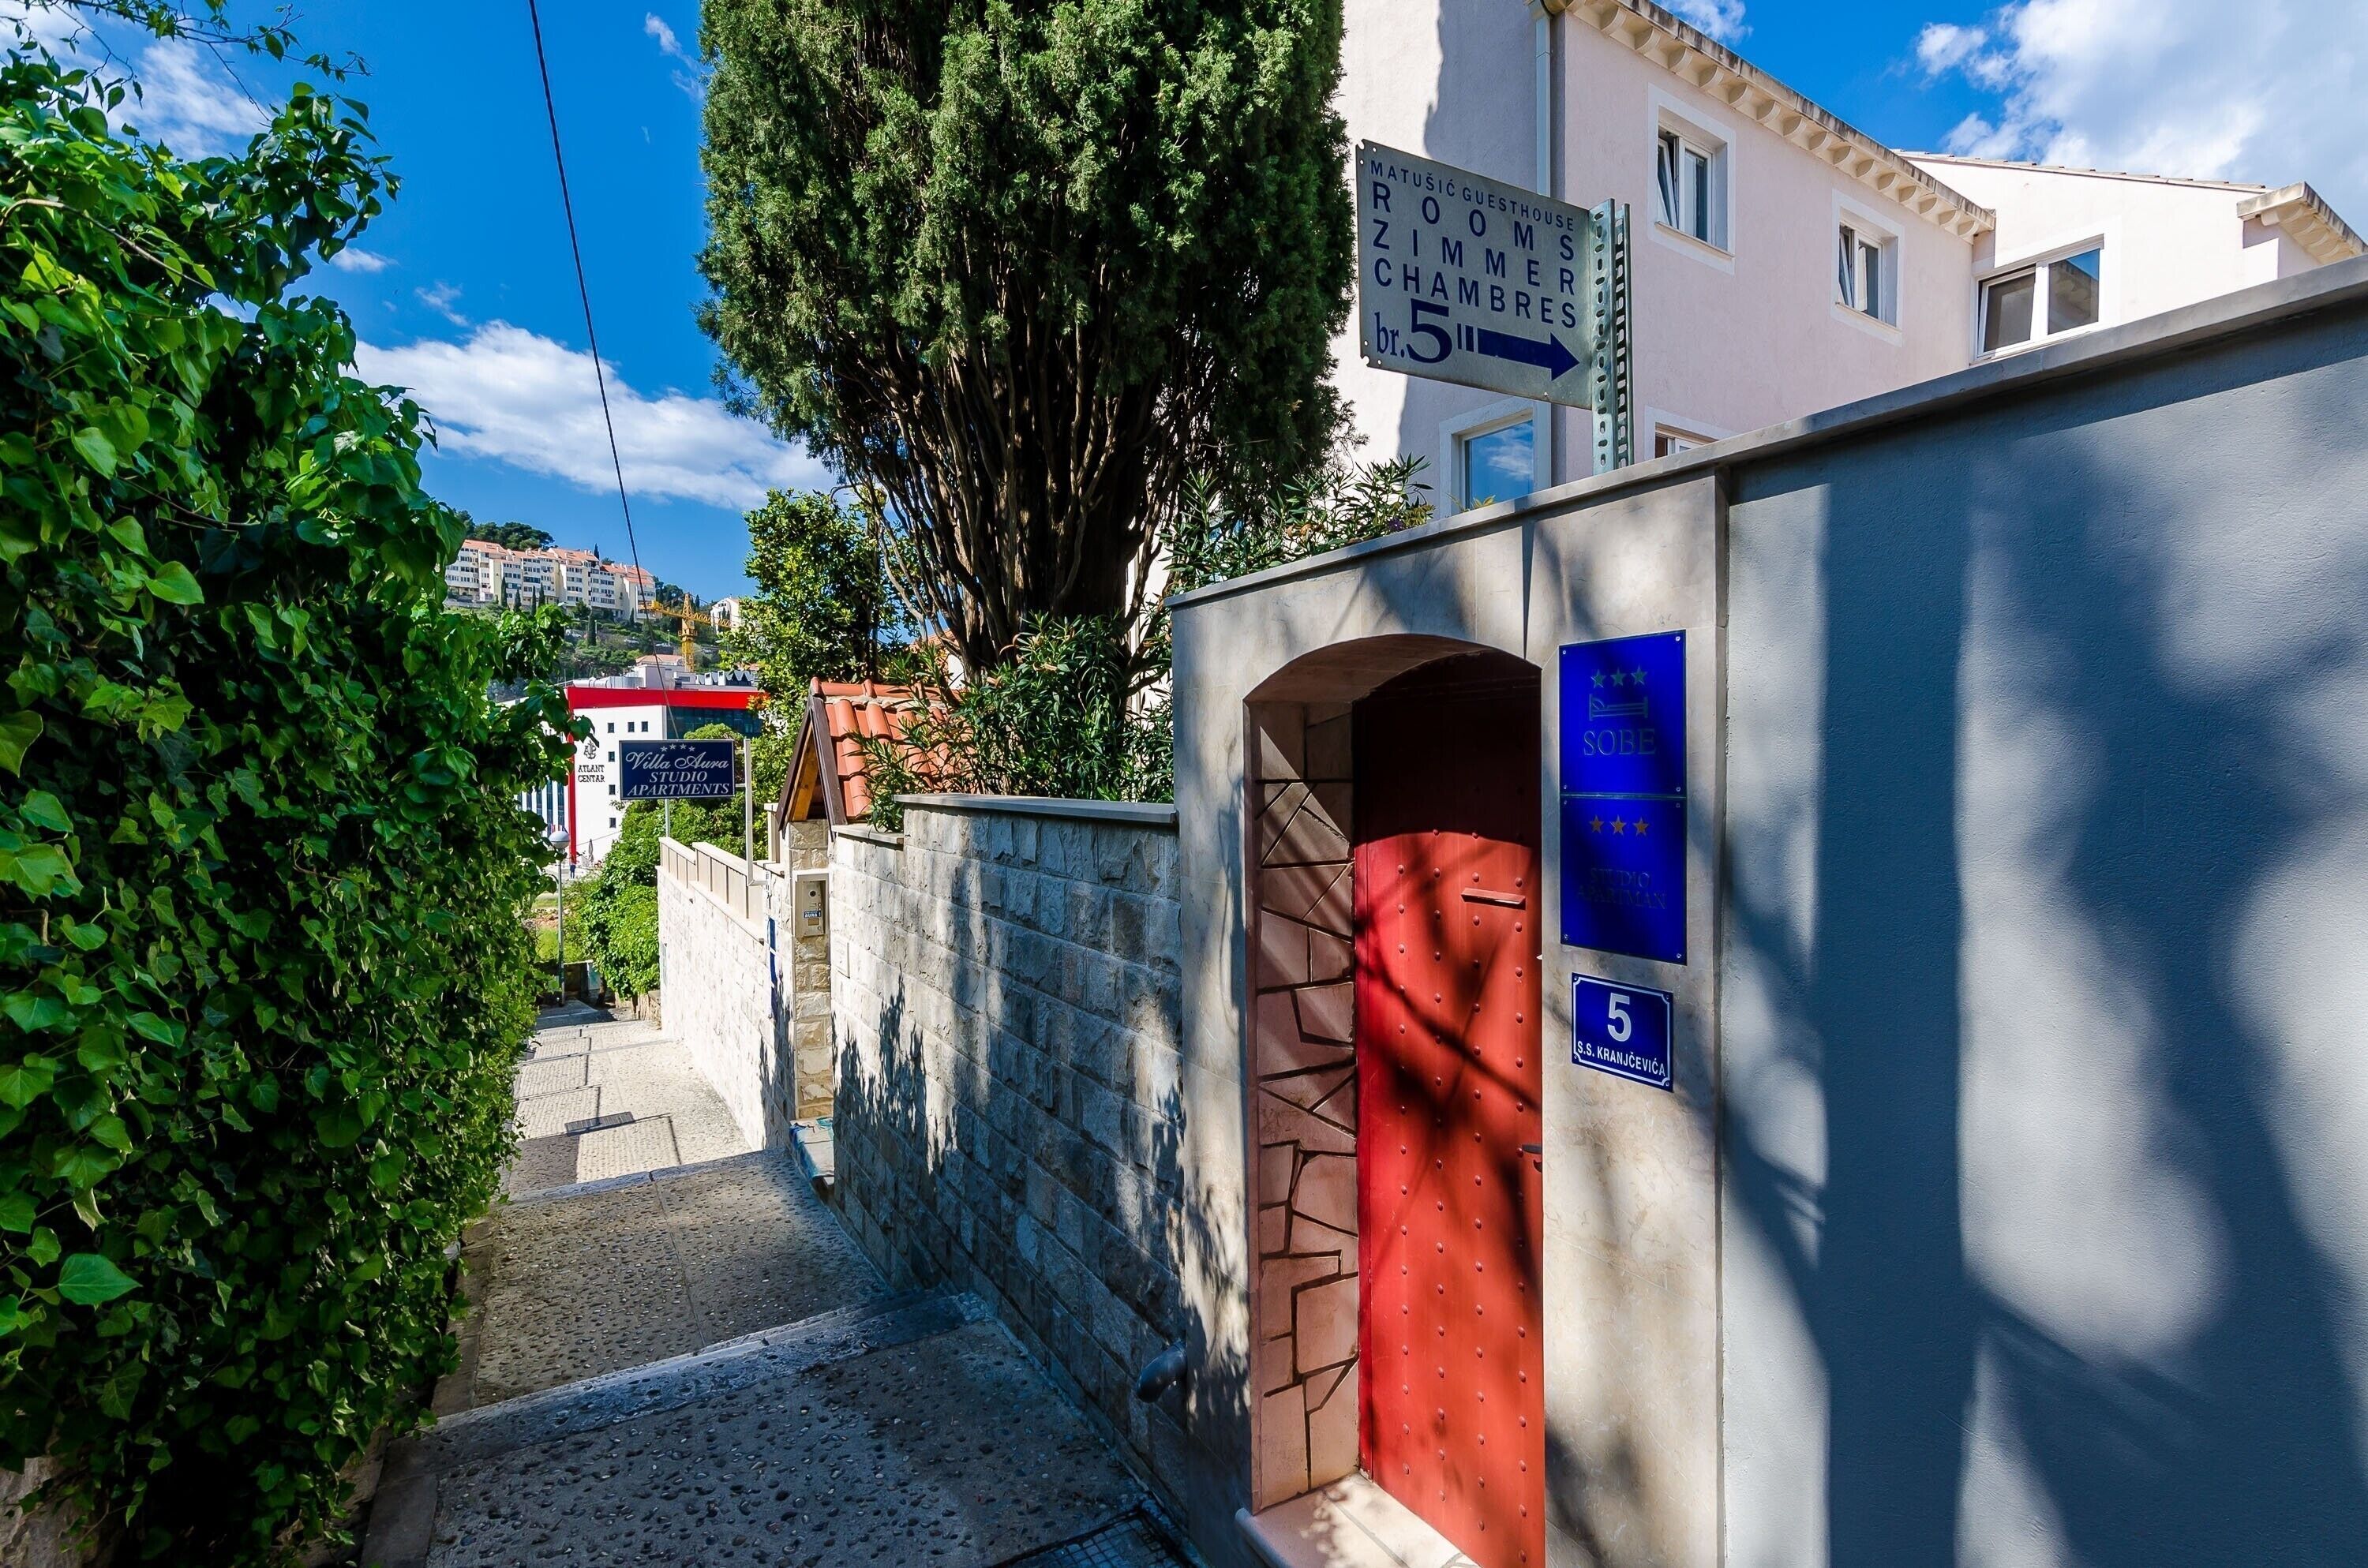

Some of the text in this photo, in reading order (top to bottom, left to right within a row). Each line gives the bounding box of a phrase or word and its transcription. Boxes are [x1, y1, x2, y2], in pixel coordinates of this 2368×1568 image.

[1370, 159, 1574, 231] MATUŠIĆ GUESTHOUSE
[1372, 181, 1575, 261] ROOMS
[1373, 219, 1575, 296] ZIMMER
[1374, 256, 1576, 329] CHAMBRES
[1583, 728, 1656, 756] SOBE
[578, 764, 605, 773] ATLANT
[625, 750, 729, 770] Villa Aura
[578, 774, 605, 783] CENTAR
[626, 783, 730, 796] APARTMENTS
[649, 770, 708, 783] STUDIO
[1607, 992, 1632, 1042] 5
[1597, 1045, 1665, 1077] KRANJČEVIĆA
